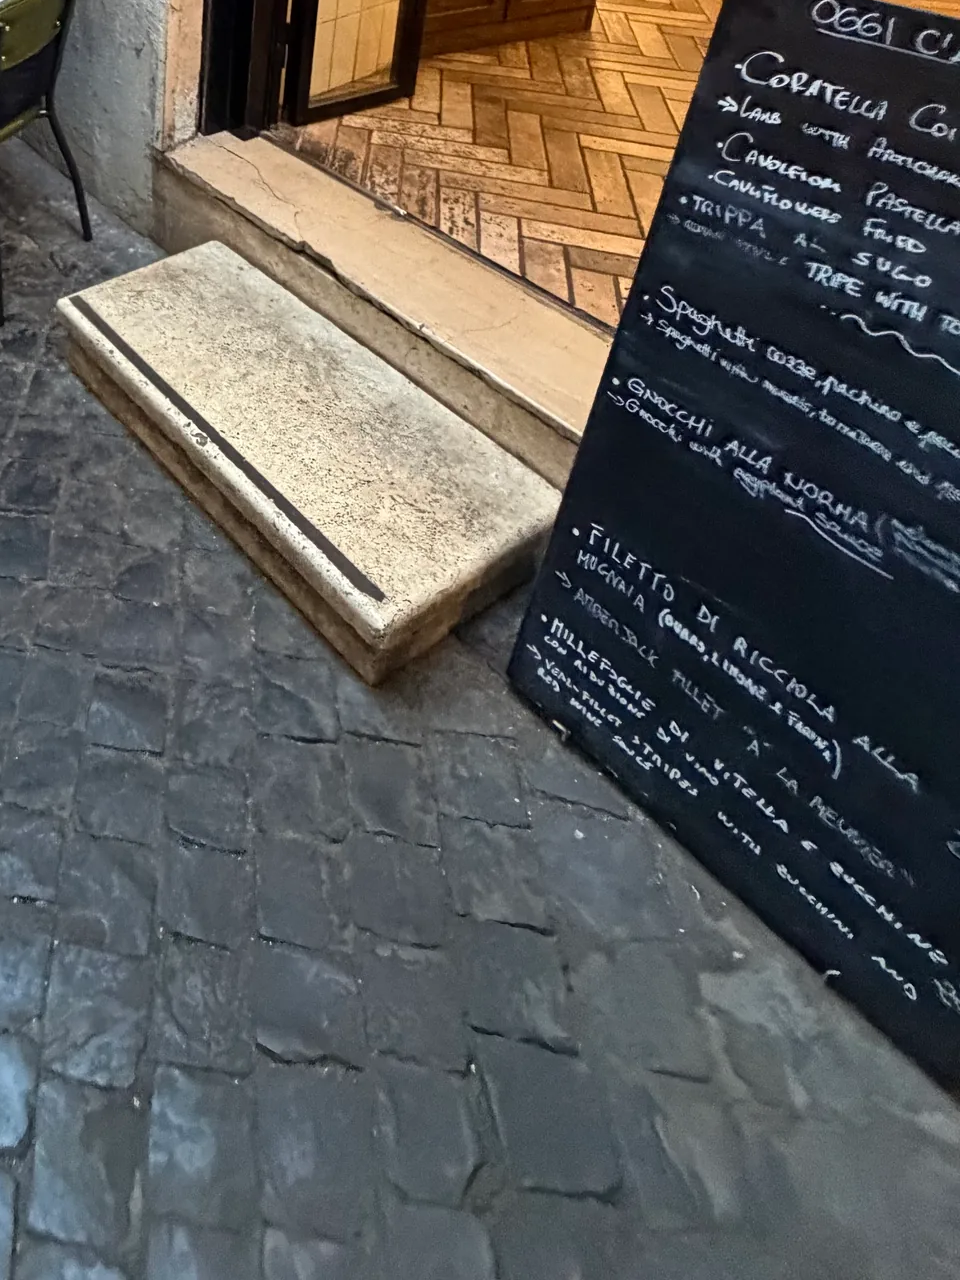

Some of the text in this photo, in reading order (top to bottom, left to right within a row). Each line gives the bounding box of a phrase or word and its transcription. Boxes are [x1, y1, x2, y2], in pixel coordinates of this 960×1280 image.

[915, 29, 960, 63] C'
[740, 95, 782, 125] LAMB
[741, 51, 889, 120] CORATELLA
[692, 195, 766, 239] TRIPPA
[851, 252, 933, 288] SUGO
[656, 286, 760, 352] Spaghetti
[805, 261, 865, 297] TRIPE
[875, 291, 928, 322] WITH
[724, 440, 772, 474] ALLA
[784, 472, 869, 533] NORMA
[577, 549, 645, 613] MUGNAIA
[588, 522, 920, 794] FILETTO DI RICCIOLA ALLA
[537, 667, 561, 693] RED
[569, 697, 603, 727] WINE
[543, 635, 720, 787] CON RIDUZIONE DI VINO
[550, 617, 656, 712] MILLEFOGLIE
[669, 720, 690, 743] DI
[713, 758, 789, 834] VITELLA
[829, 861, 949, 965] ZUCCHINE
[775, 766, 799, 797] LA
[632, 734, 699, 797] STRIPES
[871, 955, 917, 1001] AND
